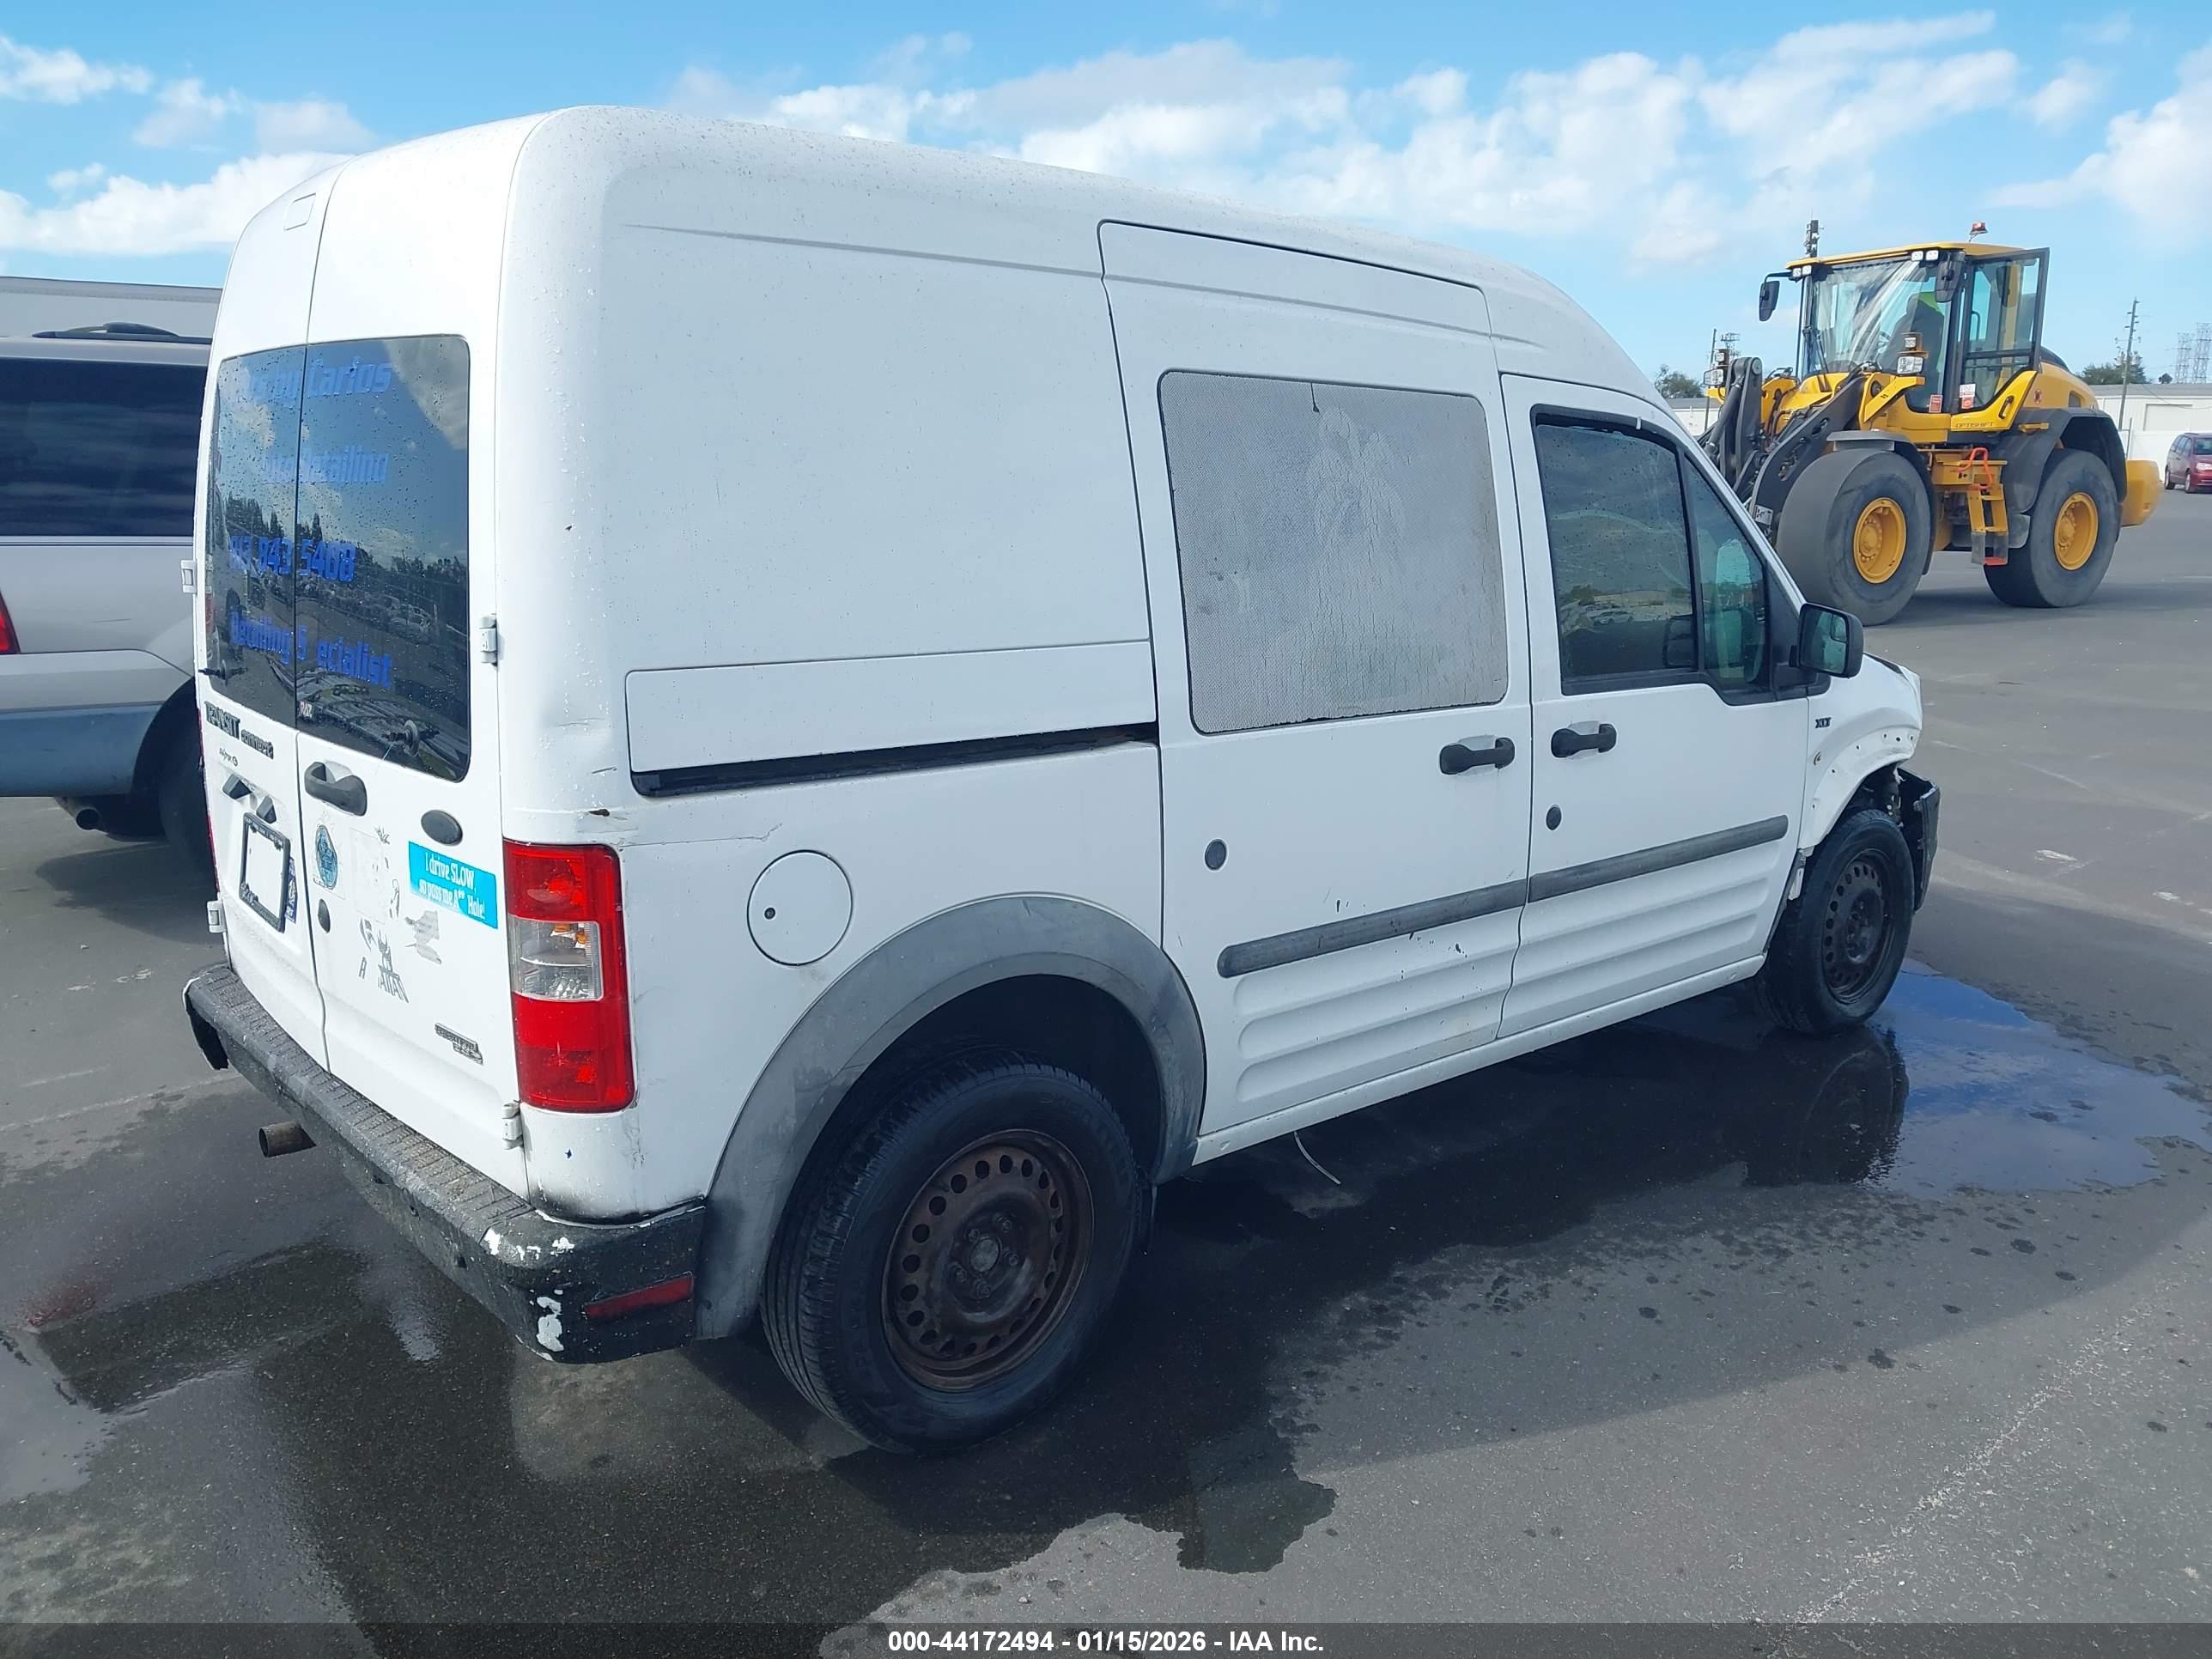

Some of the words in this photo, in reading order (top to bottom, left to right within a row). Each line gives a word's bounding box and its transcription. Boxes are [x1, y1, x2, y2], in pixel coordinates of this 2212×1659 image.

[301, 539, 357, 582] 5408
[204, 700, 241, 740] TRANSIT
[429, 854, 450, 881] drive
[427, 880, 442, 902] pass
[467, 894, 486, 921] Hole!
